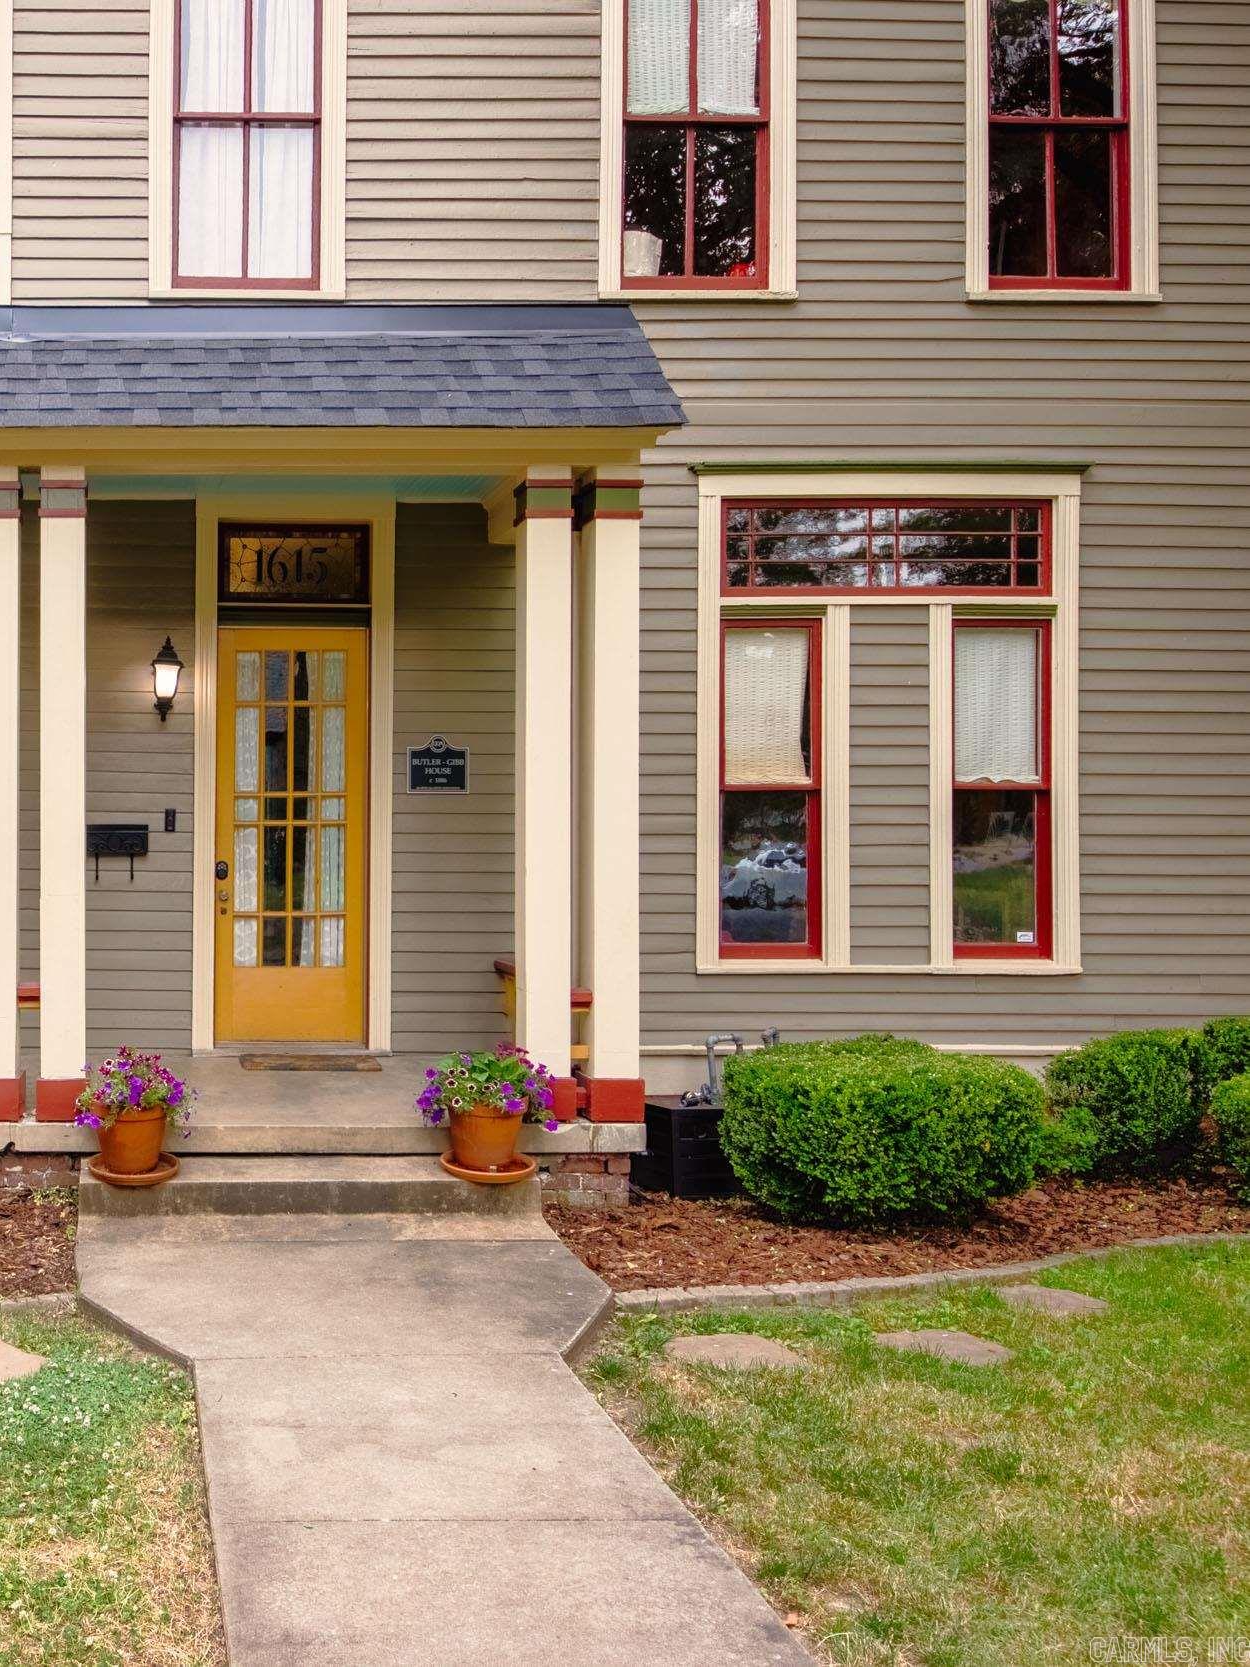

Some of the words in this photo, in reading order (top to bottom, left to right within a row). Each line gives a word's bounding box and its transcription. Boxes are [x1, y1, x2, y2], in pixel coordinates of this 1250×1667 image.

[255, 546, 329, 584] 1615
[412, 758, 441, 766] BUTLER
[425, 767, 452, 775] HOUSE
